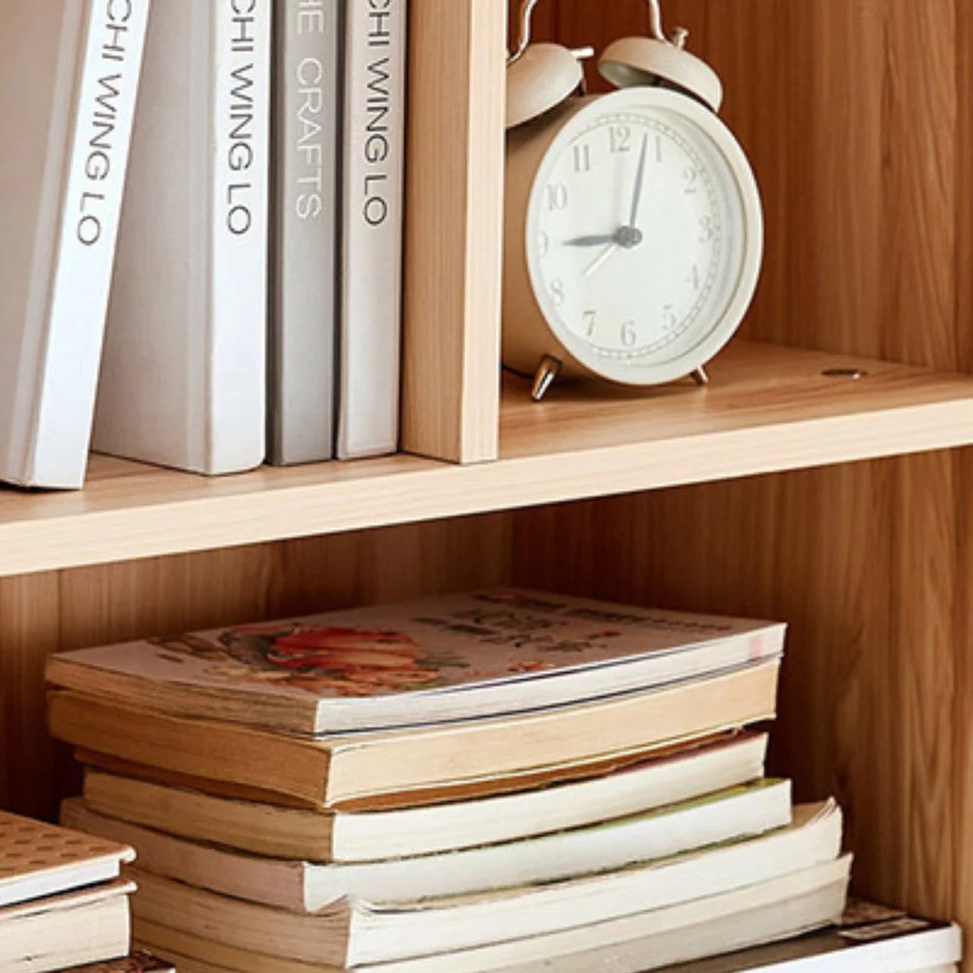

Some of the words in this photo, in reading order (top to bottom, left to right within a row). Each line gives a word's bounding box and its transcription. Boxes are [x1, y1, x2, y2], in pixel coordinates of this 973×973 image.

[228, 63, 254, 171] WING
[365, 58, 390, 163] WING
[85, 73, 122, 181] WING
[295, 58, 323, 219] CRAFTS
[609, 126, 631, 153] 12
[573, 145, 590, 172] 11
[683, 169, 697, 194] 2
[227, 184, 252, 234] LO
[364, 175, 387, 226] LO
[546, 184, 567, 211] 10
[77, 191, 105, 246] LO
[699, 216, 713, 242] 3
[687, 266, 700, 290] 4
[549, 279, 565, 306] 8
[582, 310, 597, 337] 7
[662, 304, 676, 330] 5
[620, 320, 636, 346] 6
